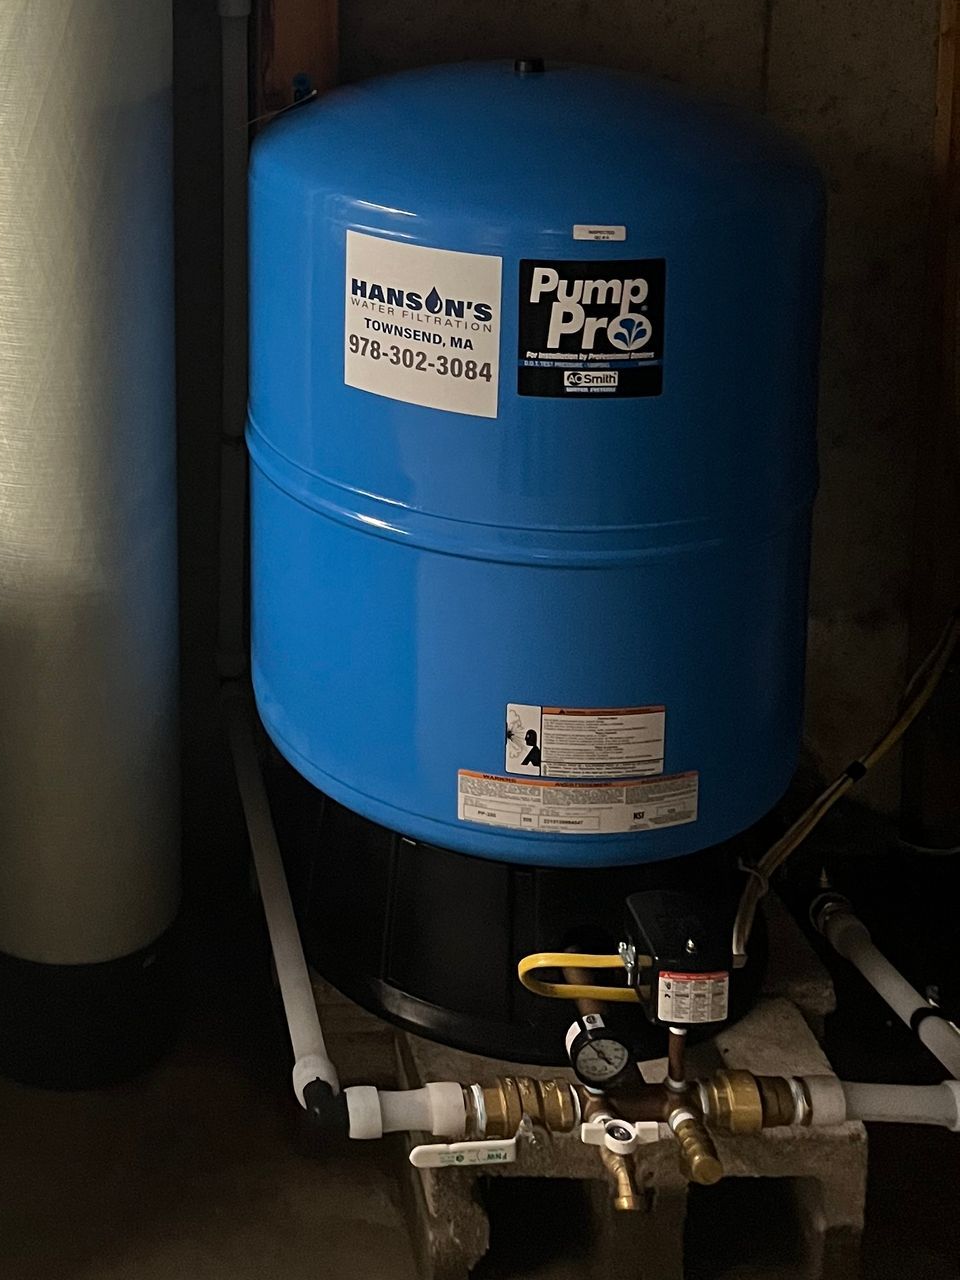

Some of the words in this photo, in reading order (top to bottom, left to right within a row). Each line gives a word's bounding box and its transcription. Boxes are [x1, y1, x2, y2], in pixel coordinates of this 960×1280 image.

[351, 278, 493, 322] HANSON'S
[529, 266, 649, 314] Pump
[351, 297, 395, 317] WATER
[402, 310, 493, 333] FILTRATION
[546, 301, 653, 351] Pro
[364, 317, 447, 348] TOWNSEND,
[450, 336, 474, 351] MA
[349, 333, 493, 383] 978-302-3084
[526, 351, 538, 359] For
[579, 353, 588, 361] by
[583, 373, 616, 384] Smith
[486, 1152, 508, 1161] FNW
